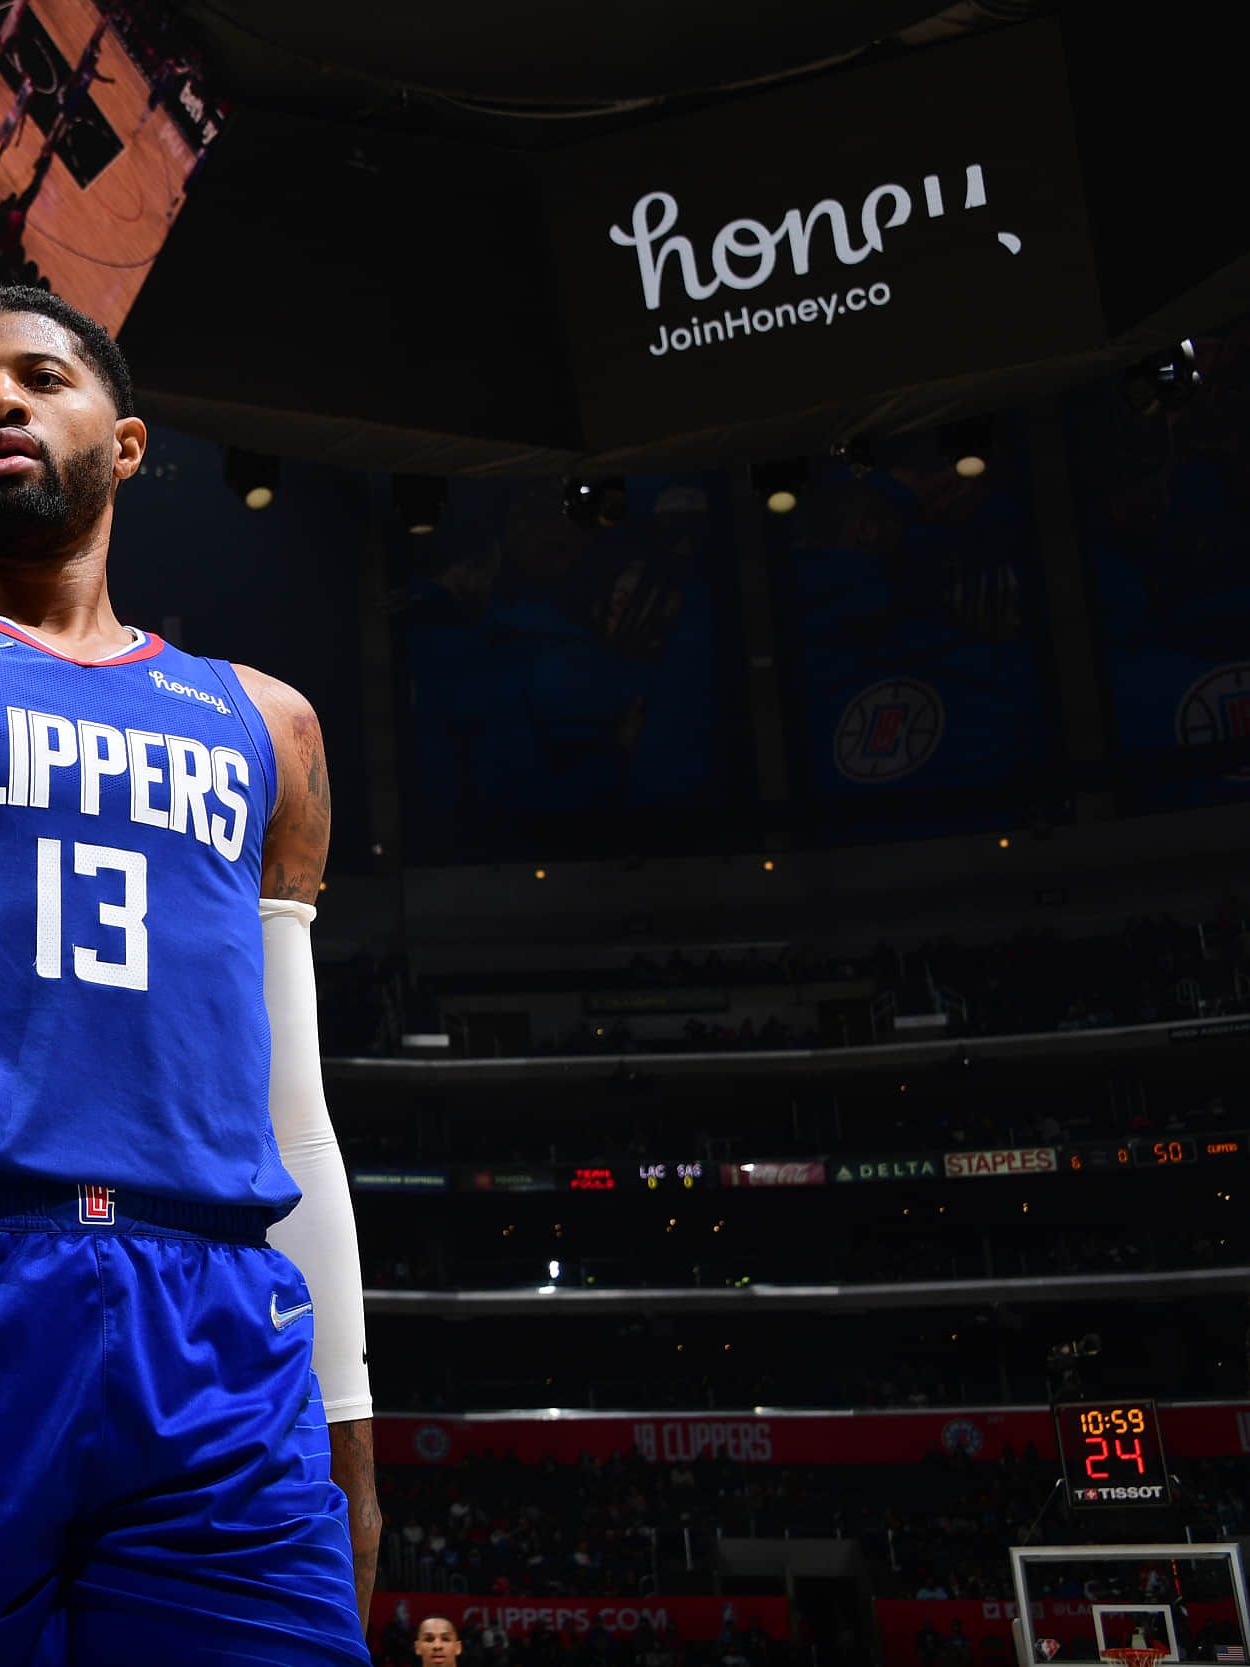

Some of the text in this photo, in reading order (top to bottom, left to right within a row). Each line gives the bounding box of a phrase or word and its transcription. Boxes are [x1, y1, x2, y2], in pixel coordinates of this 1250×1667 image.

[649, 281, 892, 357] JoinHoney.co
[148, 668, 232, 715] honey
[34, 837, 148, 991] 13
[947, 1150, 1052, 1175] STAPLES
[1151, 1141, 1183, 1164] 50
[639, 1163, 667, 1180] LAC
[859, 1160, 935, 1179] DELTA
[1080, 1408, 1145, 1435] 10:59
[662, 1422, 772, 1463] CLIPPERS
[1085, 1437, 1145, 1480] 24
[1098, 1485, 1164, 1500] TISSOT
[462, 1606, 669, 1633] CLIPPERSCOM
